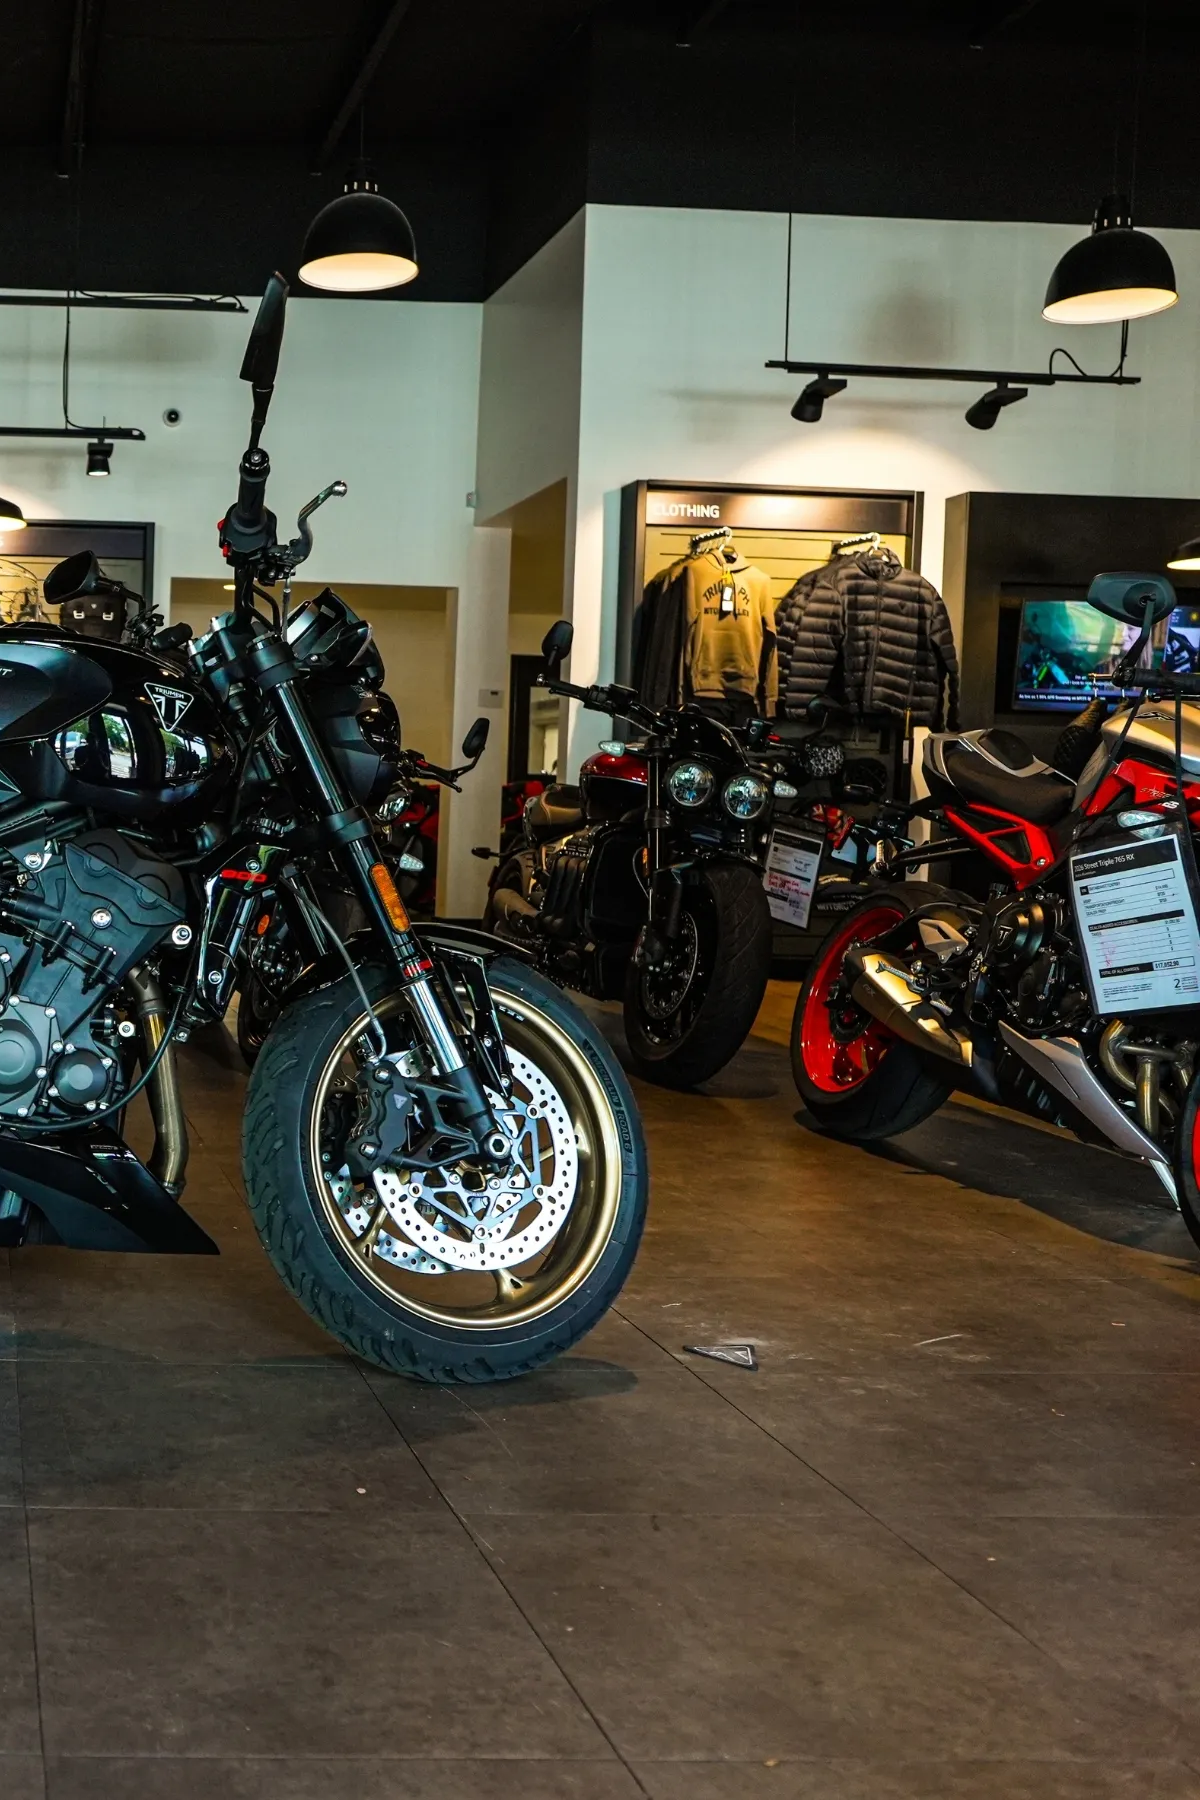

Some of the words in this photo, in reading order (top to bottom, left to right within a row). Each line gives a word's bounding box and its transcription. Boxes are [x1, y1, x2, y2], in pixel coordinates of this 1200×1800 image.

[652, 503, 720, 518] CLOTHING
[154, 687, 185, 700] TRIUMPH
[1083, 862, 1099, 870] Street
[1098, 858, 1115, 867] Triple
[1114, 855, 1126, 863] 765
[1125, 853, 1135, 861] RX
[593, 1054, 620, 1104] MICHELIN
[618, 1112, 630, 1141] ROAD
